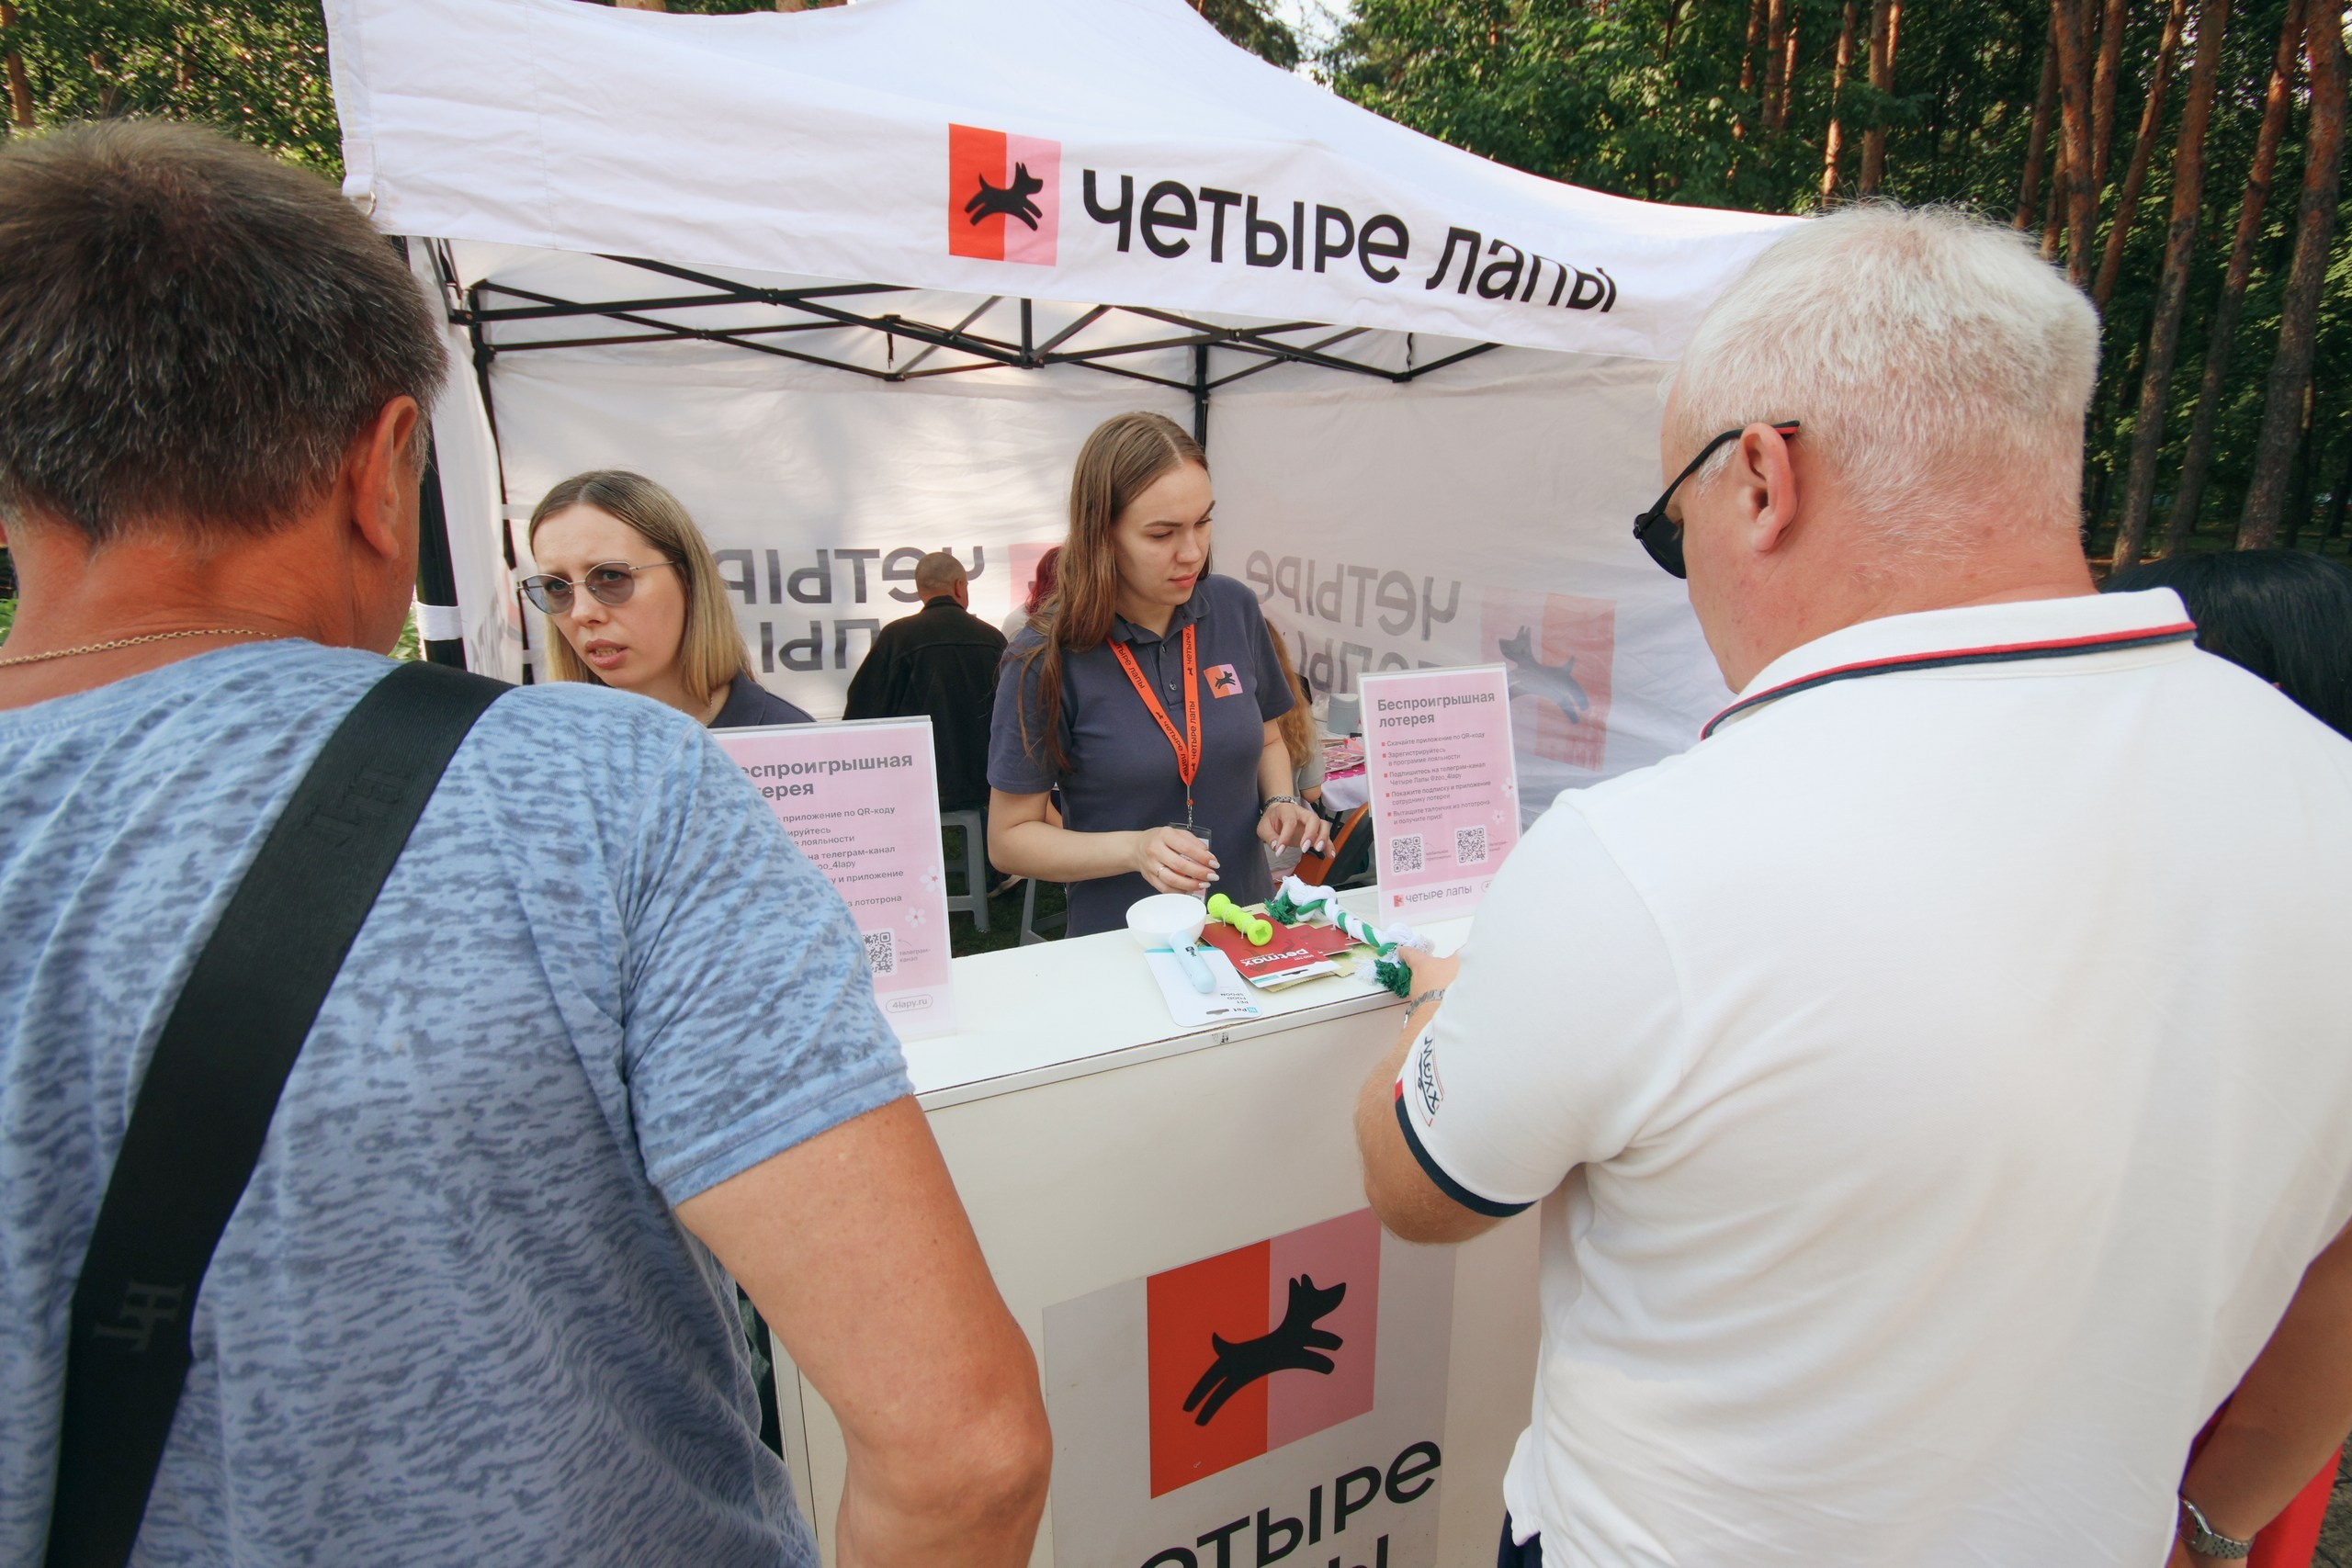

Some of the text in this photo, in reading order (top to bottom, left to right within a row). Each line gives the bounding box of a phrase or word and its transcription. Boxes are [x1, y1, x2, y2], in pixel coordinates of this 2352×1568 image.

[1083, 169, 1617, 313] четыре лапы
[1129, 667, 1146, 689] лапы
[1377, 693, 1496, 711] Беспроигрышная
[1379, 714, 1435, 728] лотерея
[1163, 721, 1183, 751] четыре
[1416, 736, 1453, 744] приложение
[741, 755, 912, 780] спроигрышная
[783, 811, 842, 823] приложение
[857, 807, 895, 816] QR-коду
[800, 835, 855, 846] лояльности
[821, 846, 896, 860] телеграм-канал
[846, 870, 904, 883] приложение
[854, 895, 902, 907] лототрона
[1406, 890, 1443, 903] четыре
[1445, 885, 1472, 897] лапы
[1244, 948, 1309, 966] petmax
[892, 998, 928, 1009] 4lapy.ru
